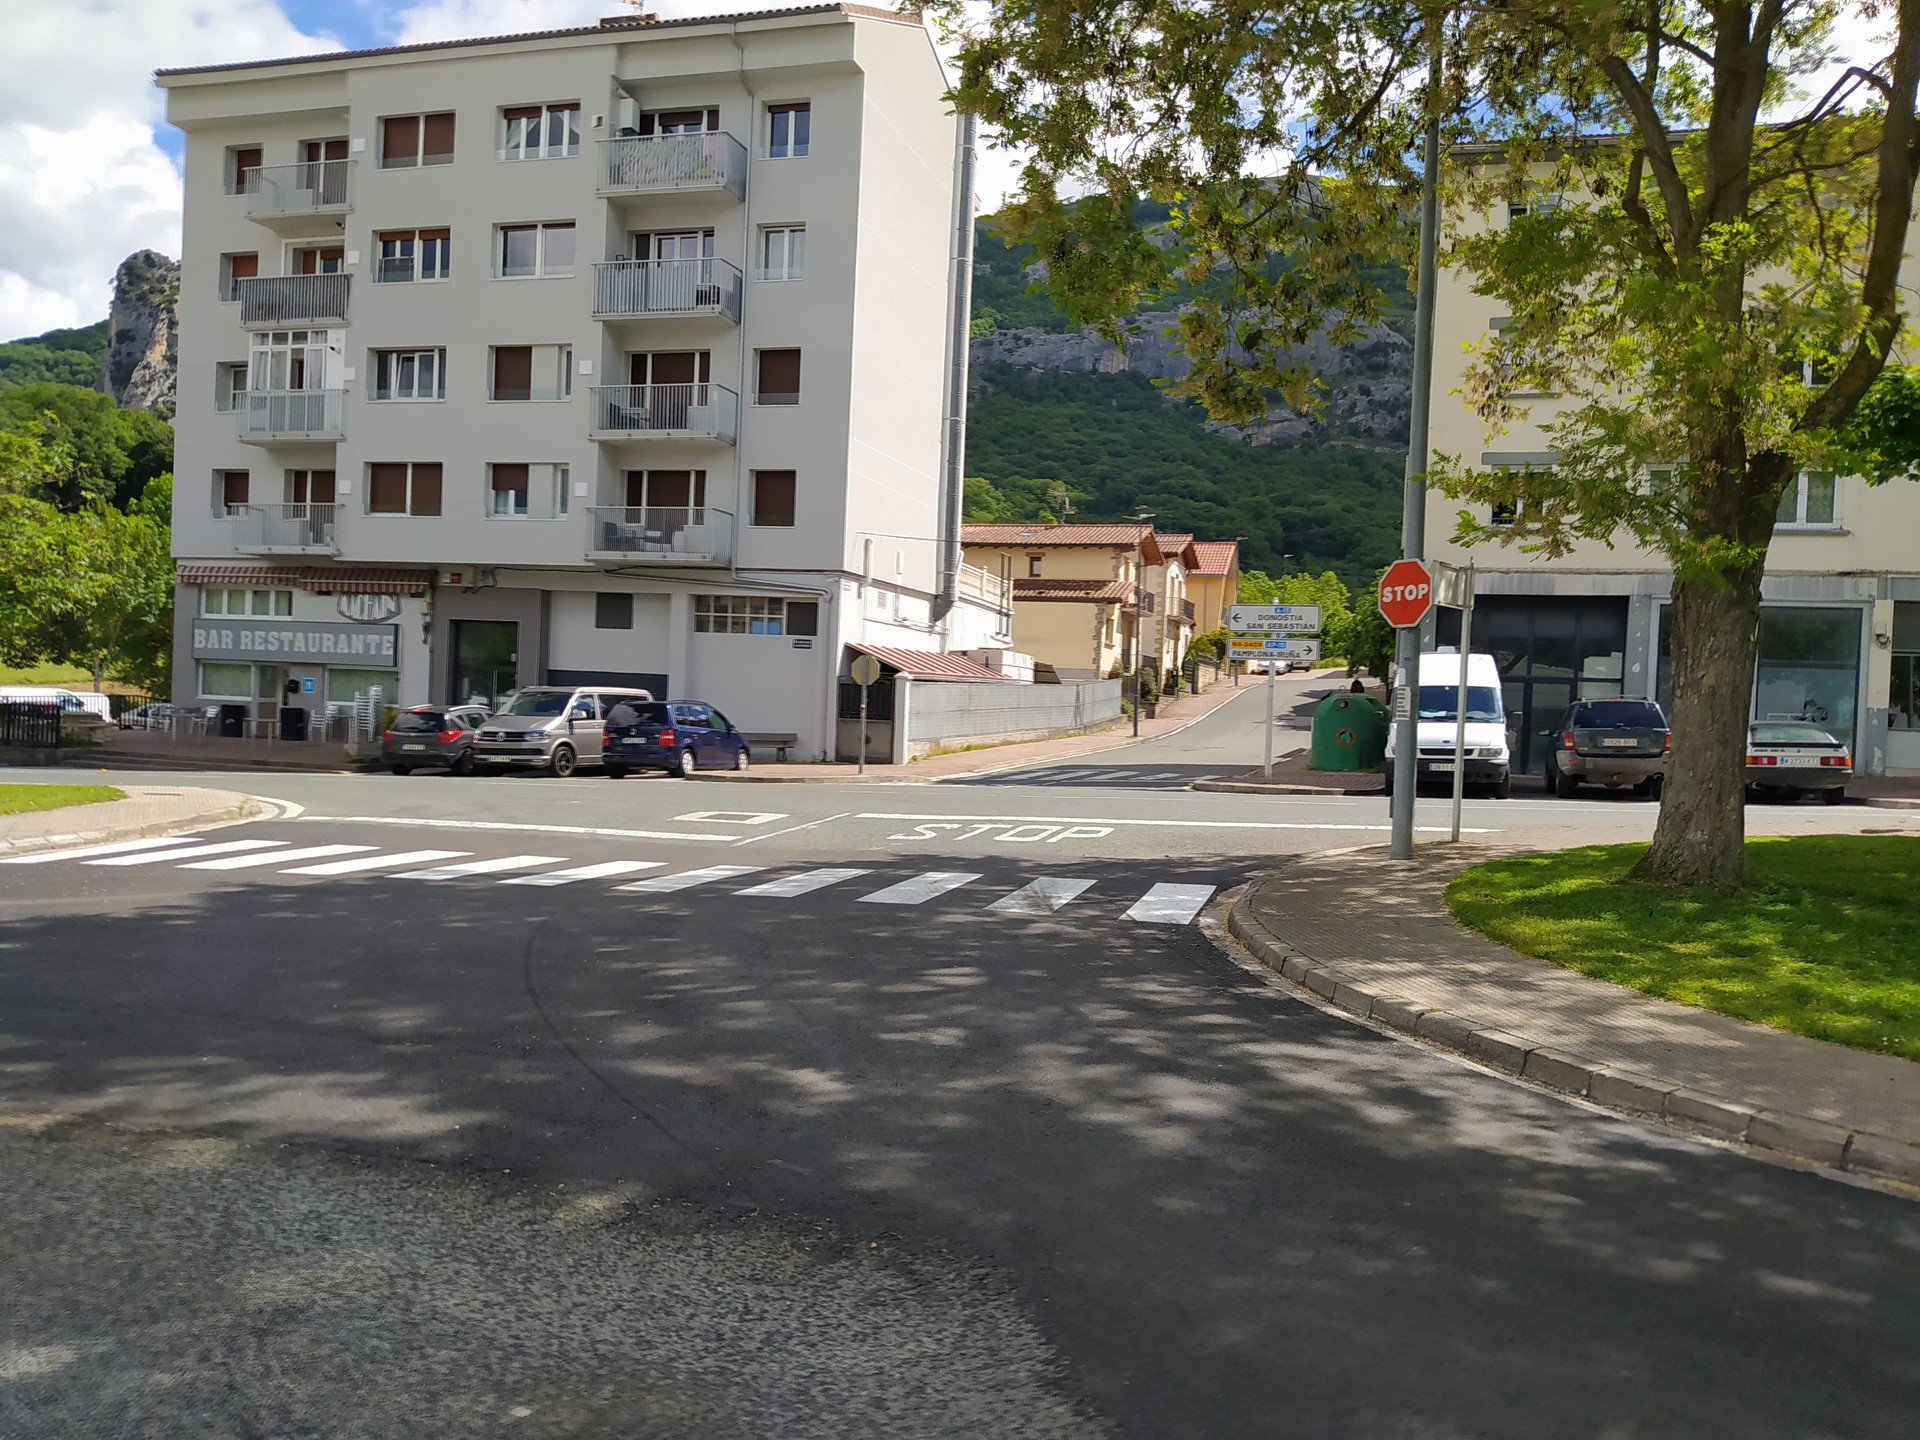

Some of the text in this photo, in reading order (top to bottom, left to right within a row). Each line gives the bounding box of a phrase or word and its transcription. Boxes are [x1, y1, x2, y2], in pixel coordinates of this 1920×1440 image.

[1381, 583, 1429, 603] STOP
[1245, 621, 1316, 630] SAN SEBASTIÁN
[193, 628, 394, 655] BAR RESTAURANTE
[886, 823, 1115, 843] STOP
